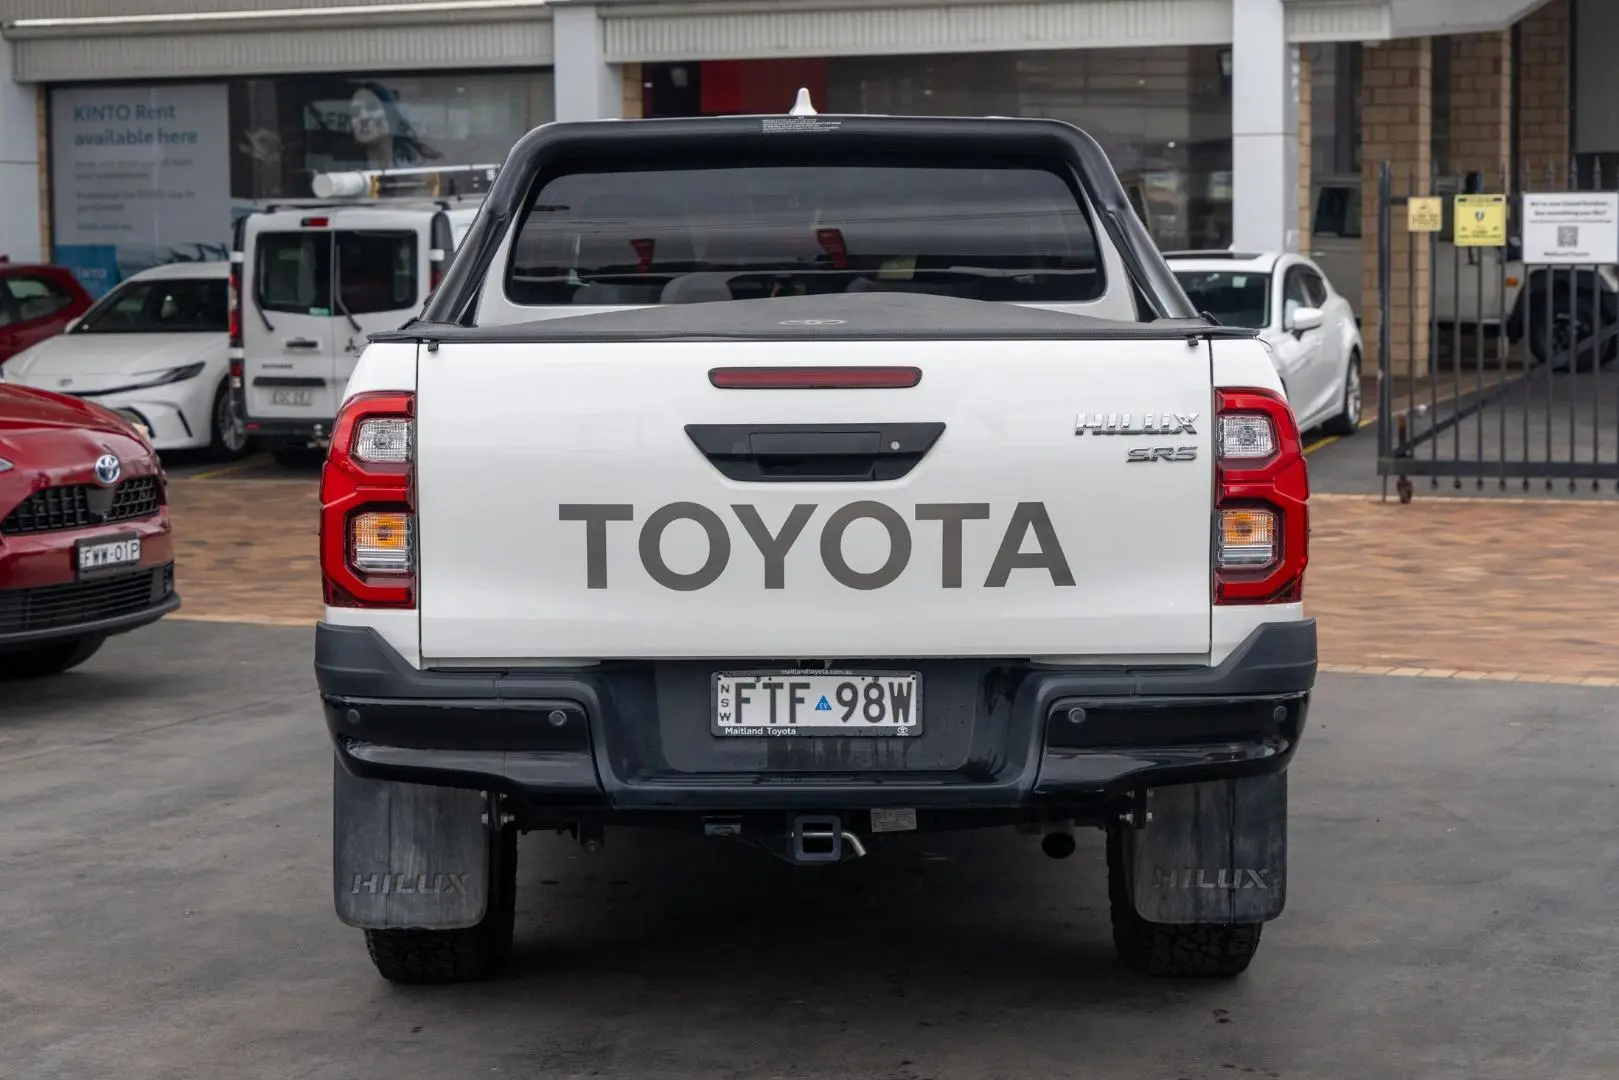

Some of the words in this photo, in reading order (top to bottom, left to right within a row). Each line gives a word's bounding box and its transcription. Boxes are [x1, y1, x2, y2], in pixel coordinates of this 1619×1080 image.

[73, 104, 131, 121] KINTO
[136, 103, 176, 120] Rent
[74, 128, 154, 147] available
[158, 127, 198, 145] here
[1075, 413, 1200, 436] HILUX
[558, 500, 1077, 592] TOYOTA
[780, 668, 853, 676] maitlandtoyota.com.au
[734, 682, 811, 724] FTF
[835, 681, 913, 724] 98W
[725, 727, 763, 736] Maitland
[767, 727, 797, 737] Toyota
[351, 872, 470, 895] HILUX
[1150, 868, 1270, 889] HILUX
